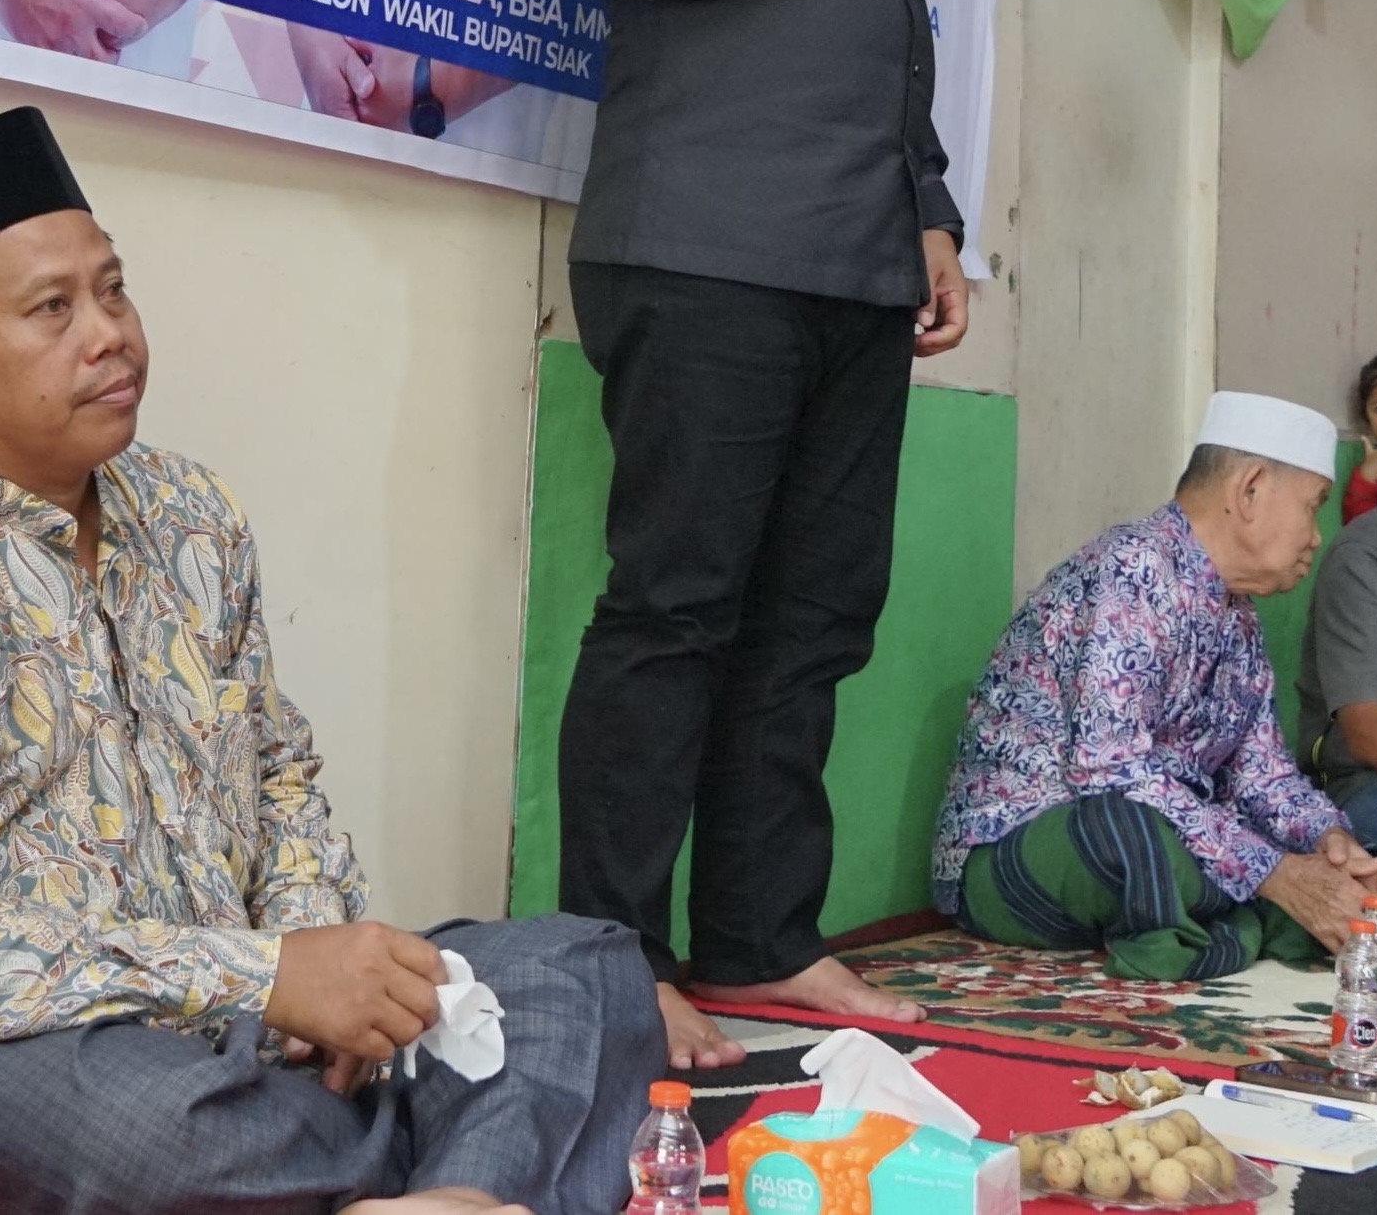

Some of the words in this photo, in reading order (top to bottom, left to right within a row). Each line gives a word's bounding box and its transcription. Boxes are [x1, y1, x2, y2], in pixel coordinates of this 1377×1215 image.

[464, 16, 542, 65] BUPATI
[544, 41, 592, 79] SIAK
[1354, 1026, 1376, 1040] Cleo
[751, 1173, 814, 1202] PASEO
